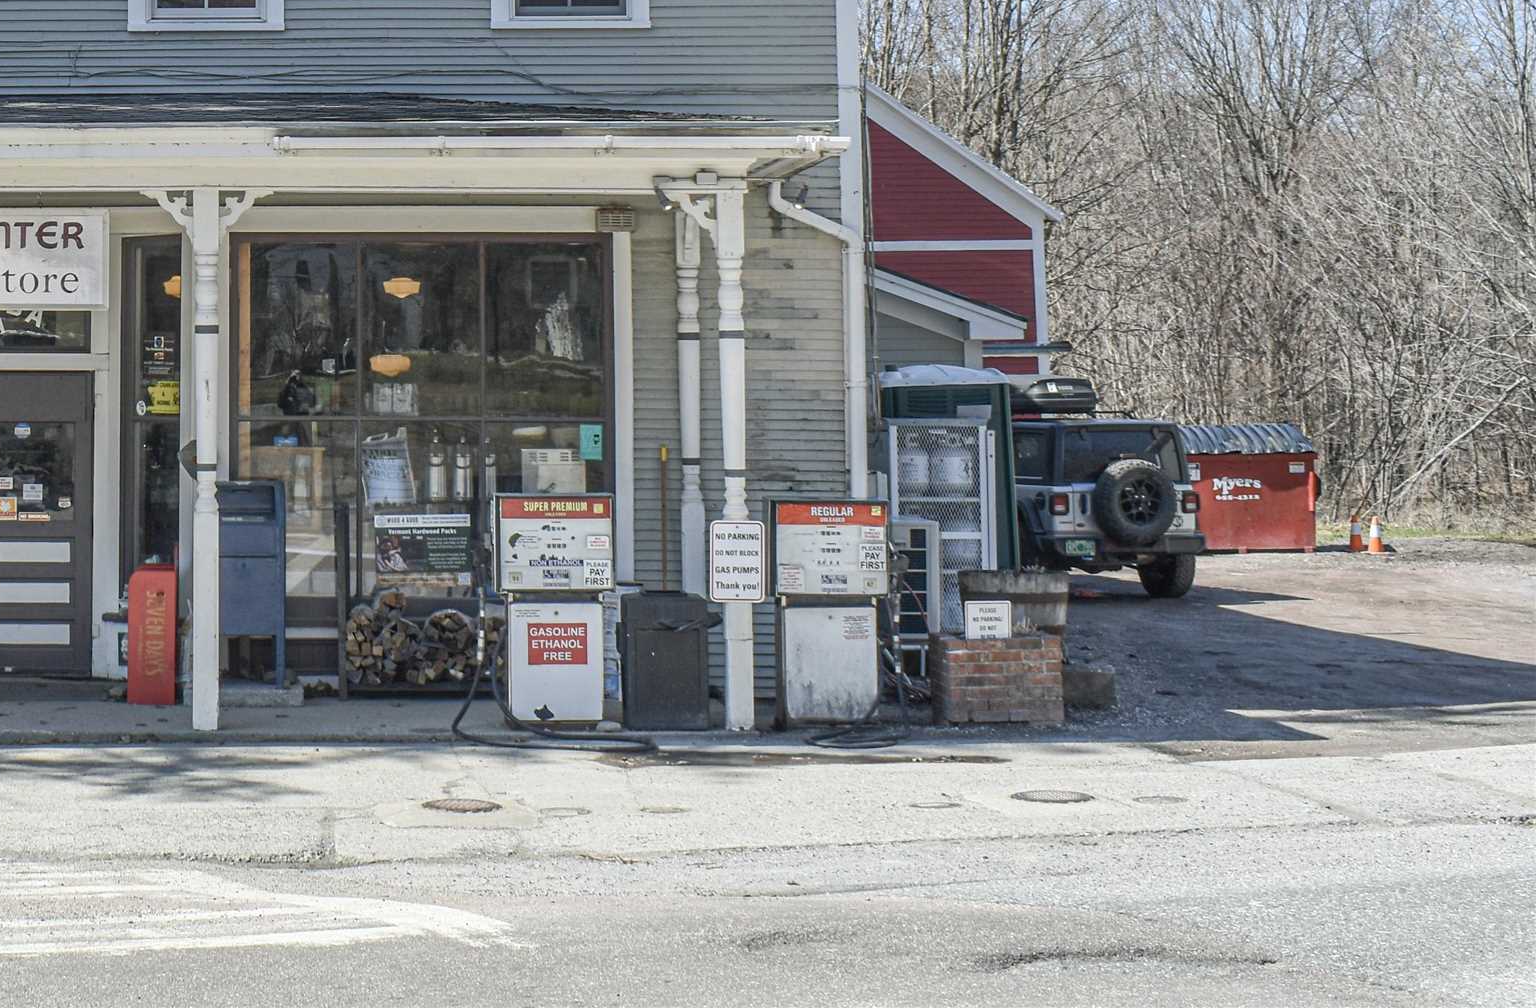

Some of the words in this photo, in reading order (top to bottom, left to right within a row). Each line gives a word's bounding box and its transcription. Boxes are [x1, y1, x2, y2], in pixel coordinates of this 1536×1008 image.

[1212, 476, 1262, 495] Myers
[523, 501, 549, 512] SUPER
[551, 501, 588, 512] PREMIUM
[810, 506, 854, 517] REGULAR
[727, 533, 759, 541] PARKING
[864, 552, 881, 561] PAY
[860, 561, 885, 569] FIRST
[589, 568, 605, 576] PAY
[732, 566, 760, 574] PUMPS
[585, 577, 610, 586] FIRST
[716, 581, 740, 589] Thank
[529, 627, 585, 637] GASOLINE
[531, 639, 583, 649] ETHANOL
[543, 651, 572, 661] FREE
